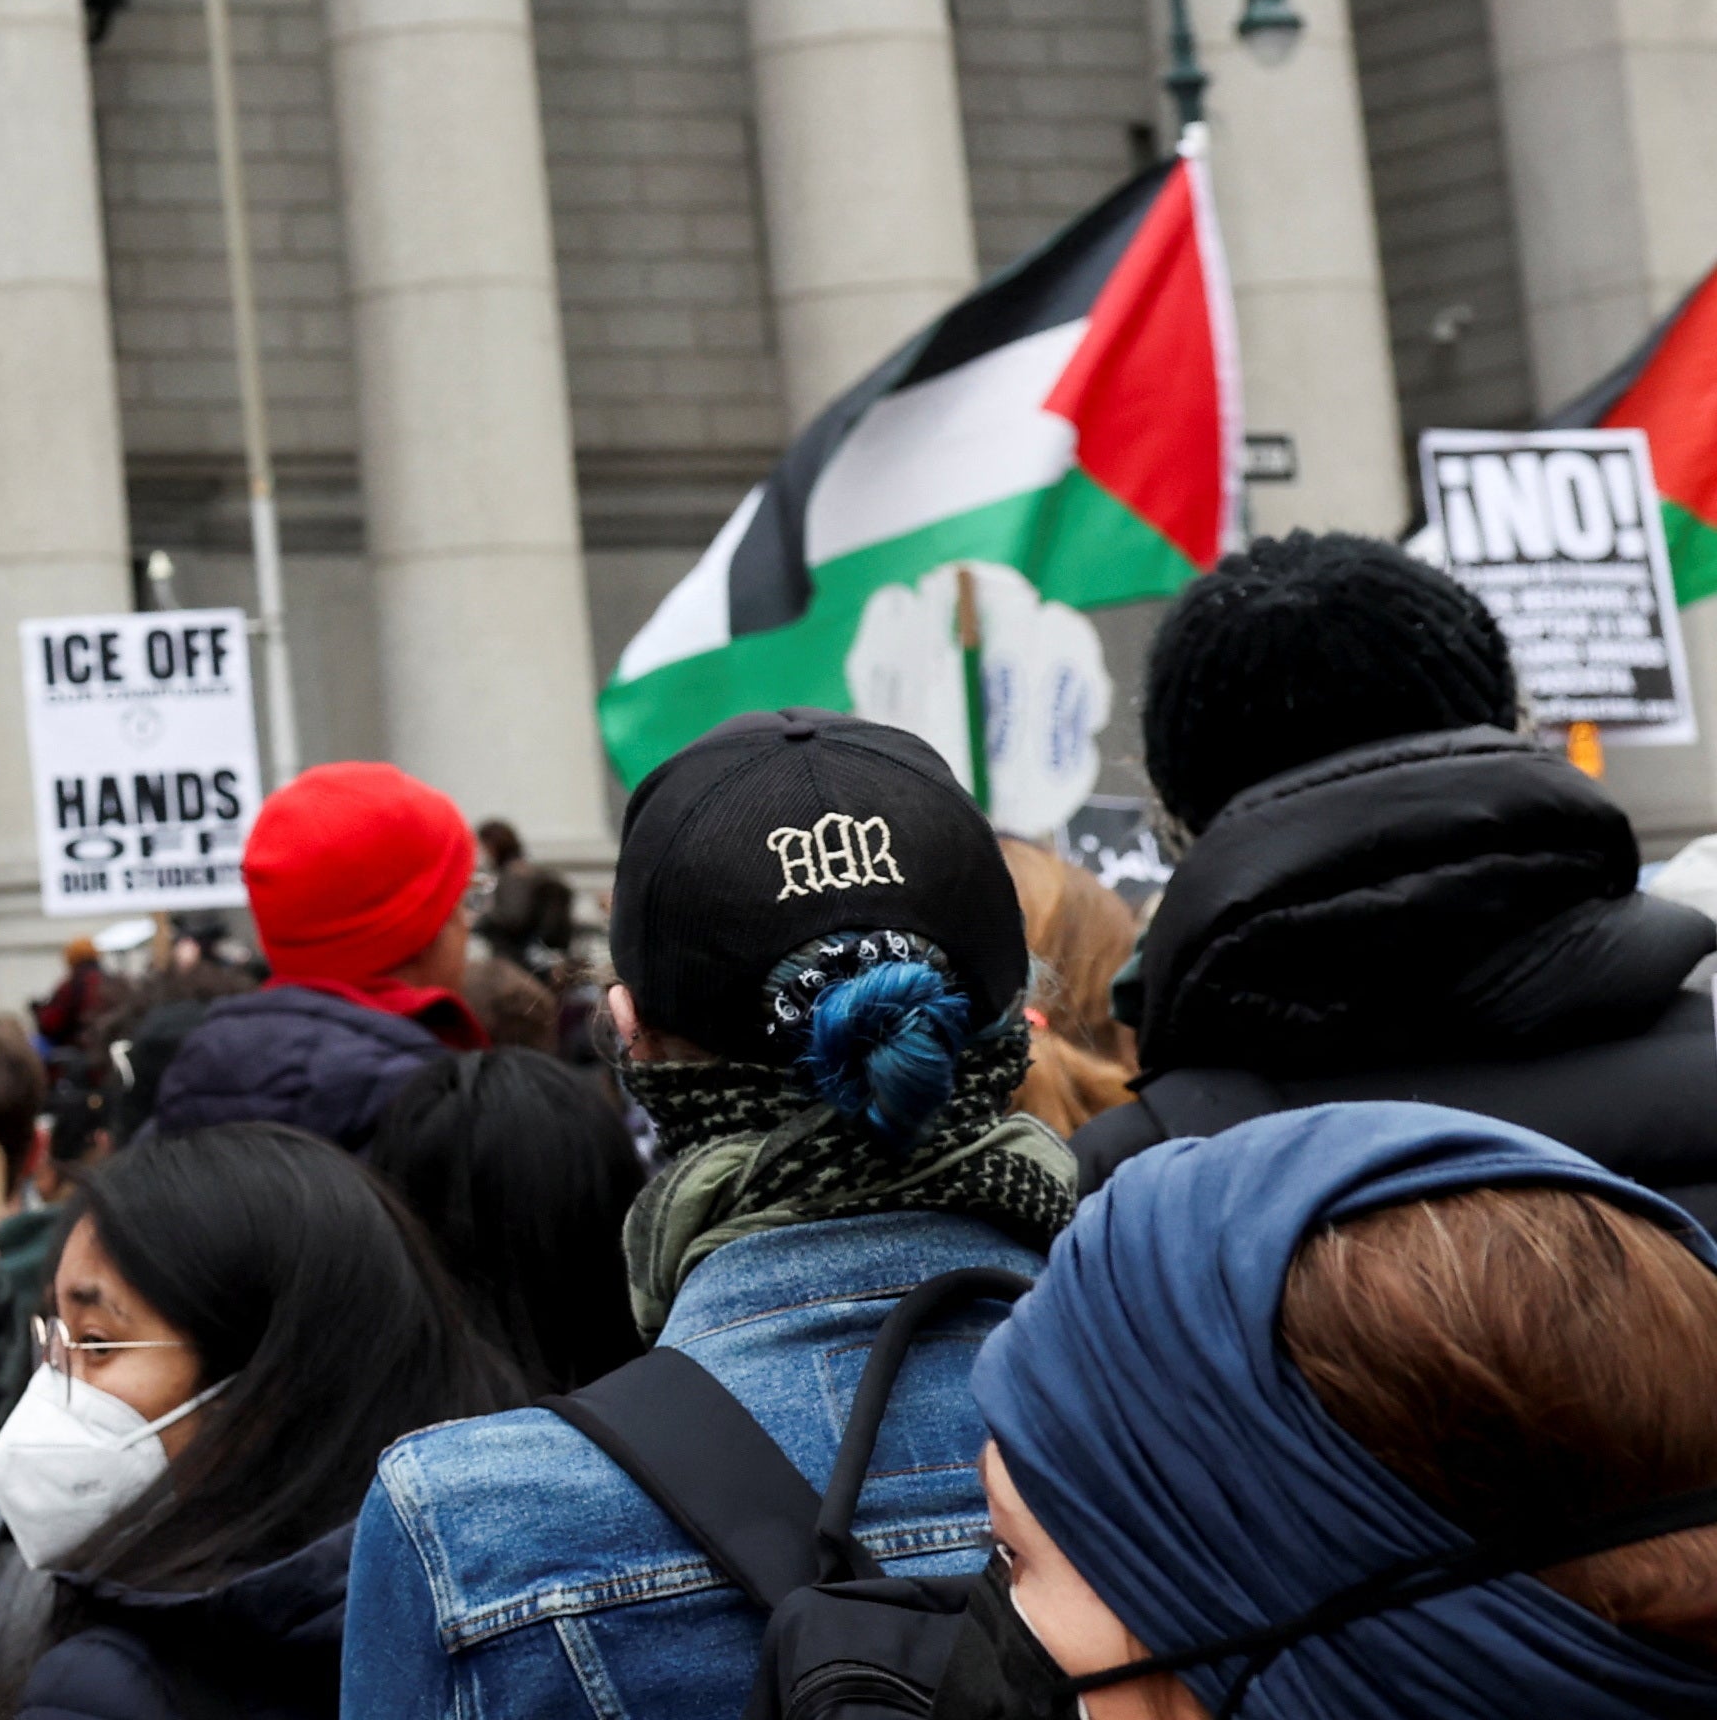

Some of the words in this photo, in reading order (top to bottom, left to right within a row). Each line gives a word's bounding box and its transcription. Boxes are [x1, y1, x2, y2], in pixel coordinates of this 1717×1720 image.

[1438, 449, 1648, 563] ¡NO!
[43, 632, 123, 686] ICE
[146, 627, 228, 680] OFF
[55, 769, 242, 829] HANDS
[64, 831, 241, 863] OFF
